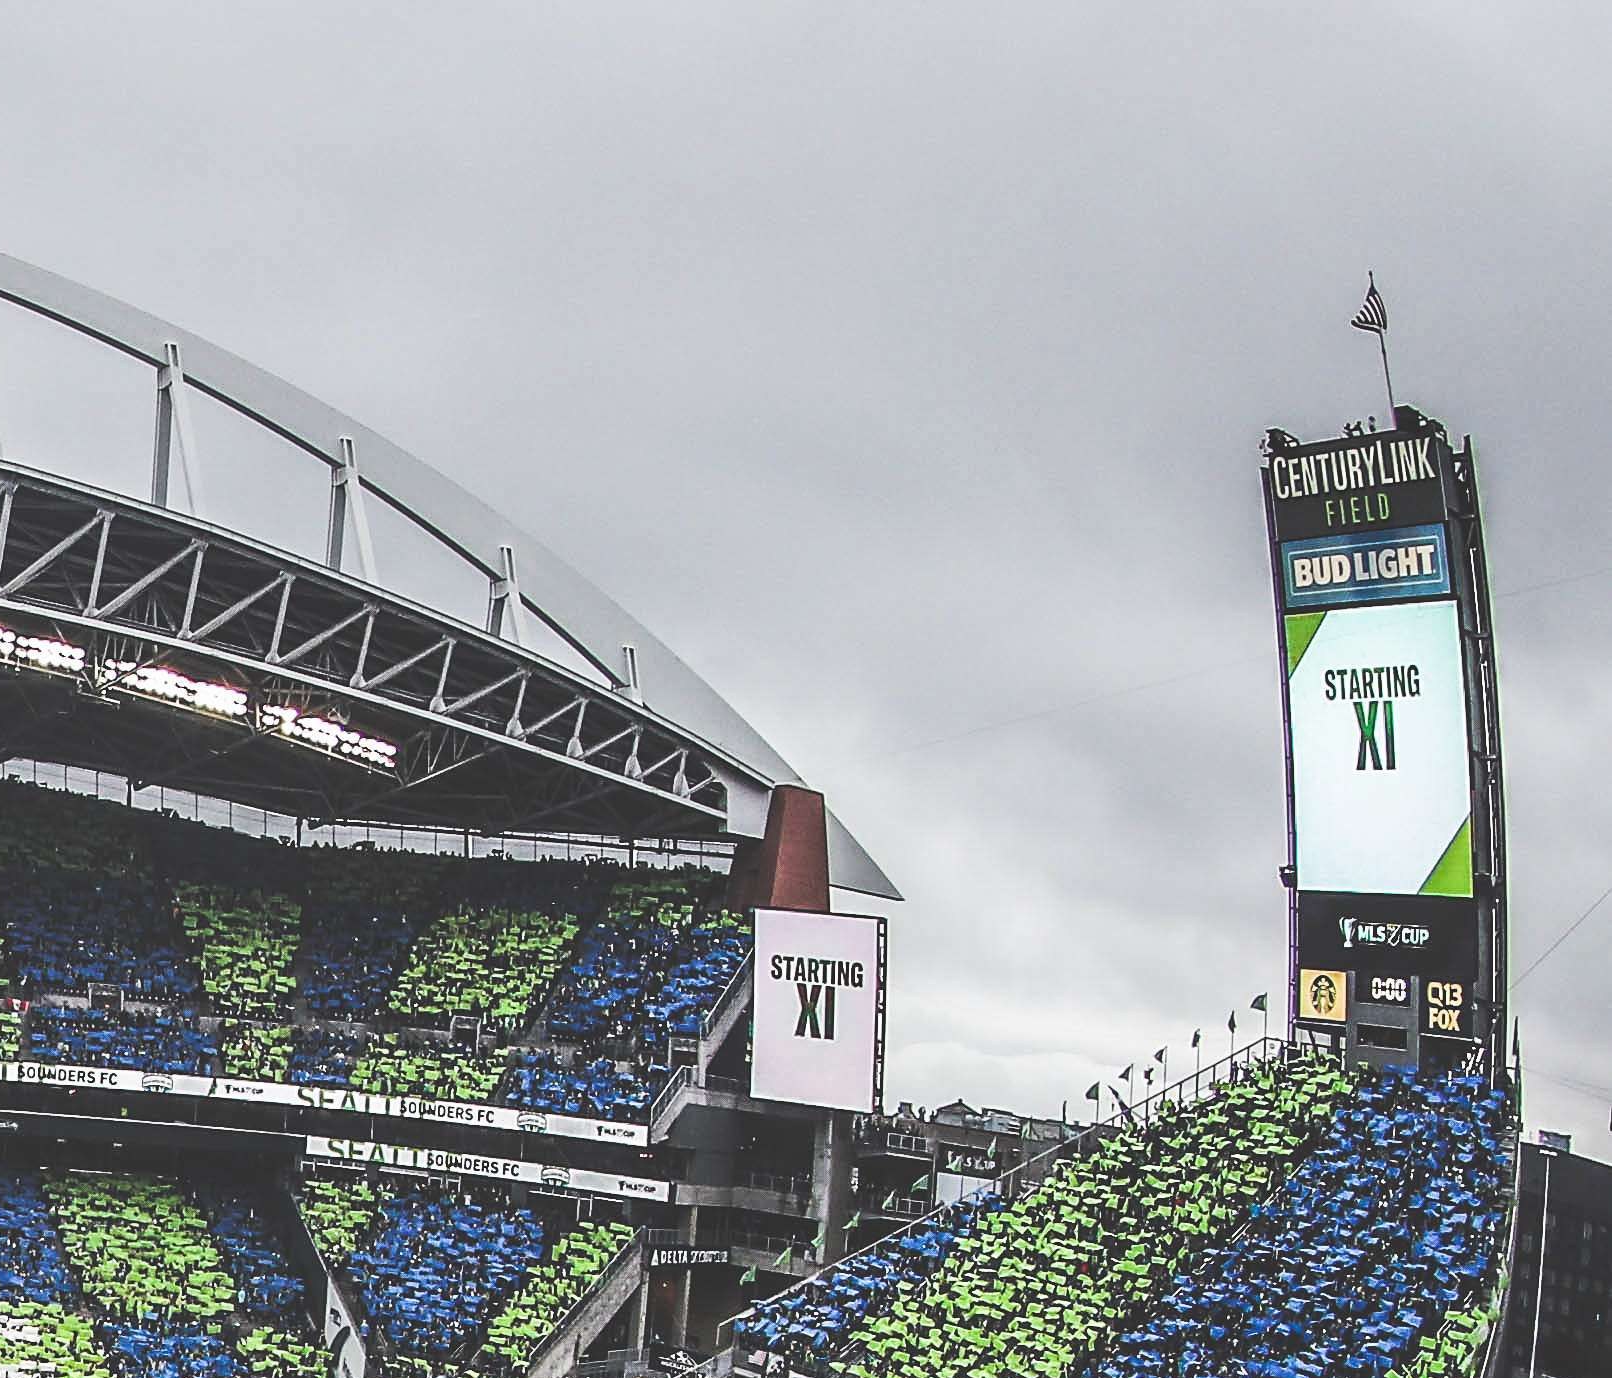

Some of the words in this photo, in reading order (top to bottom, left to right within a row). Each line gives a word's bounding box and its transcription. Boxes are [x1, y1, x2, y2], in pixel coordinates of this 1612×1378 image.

[1273, 437, 1436, 499] CENTURYLINK
[1325, 493, 1390, 525] FIELD
[1294, 554, 1351, 587] BUD
[1355, 544, 1434, 580] LIGHT
[1325, 664, 1420, 700] STARTING
[1353, 701, 1396, 770] XI
[1358, 924, 1385, 945] MLS
[1402, 927, 1429, 946] CUP
[770, 955, 864, 988] STARTING
[1371, 977, 1406, 1002] 0:00
[1427, 981, 1462, 1007] Q13
[794, 983, 835, 1040] XI
[1429, 1007, 1461, 1031] FOX
[17, 1064, 96, 1084] SOUNDERS
[99, 1071, 118, 1085] FC
[399, 1100, 474, 1121] SOUNDERS
[477, 1109, 495, 1123] FC
[427, 1151, 499, 1175] SOUNDERS
[501, 1162, 520, 1177] FC
[661, 1251, 688, 1264] DELTA
